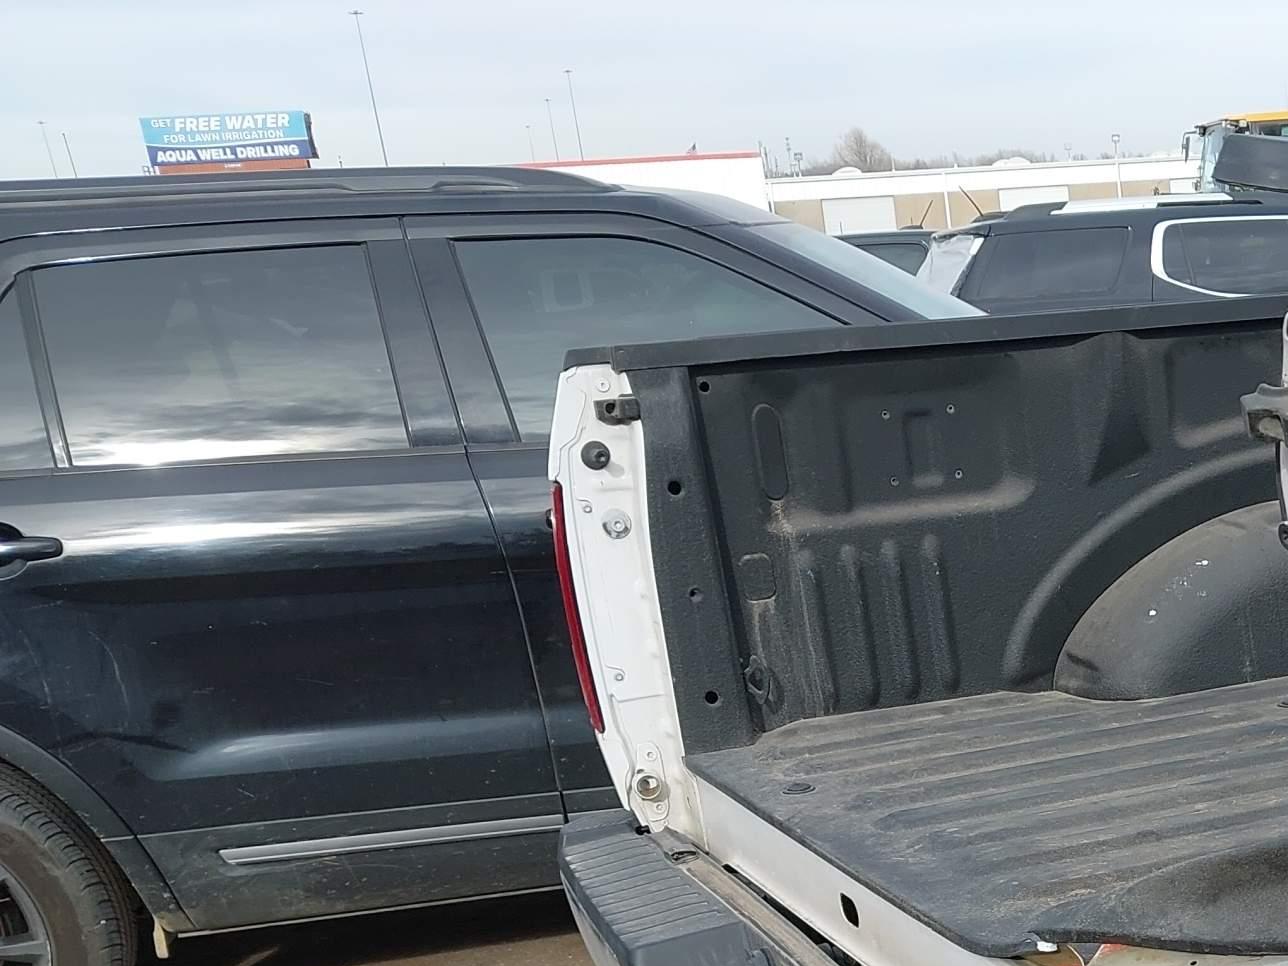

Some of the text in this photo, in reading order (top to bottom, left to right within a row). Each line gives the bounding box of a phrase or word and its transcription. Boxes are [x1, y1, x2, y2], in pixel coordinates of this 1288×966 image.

[151, 113, 290, 132] GET FREE WATER
[164, 130, 284, 144] FOR LAWN IRRIGATION
[157, 144, 299, 163] AQUA WELL DRILLING
